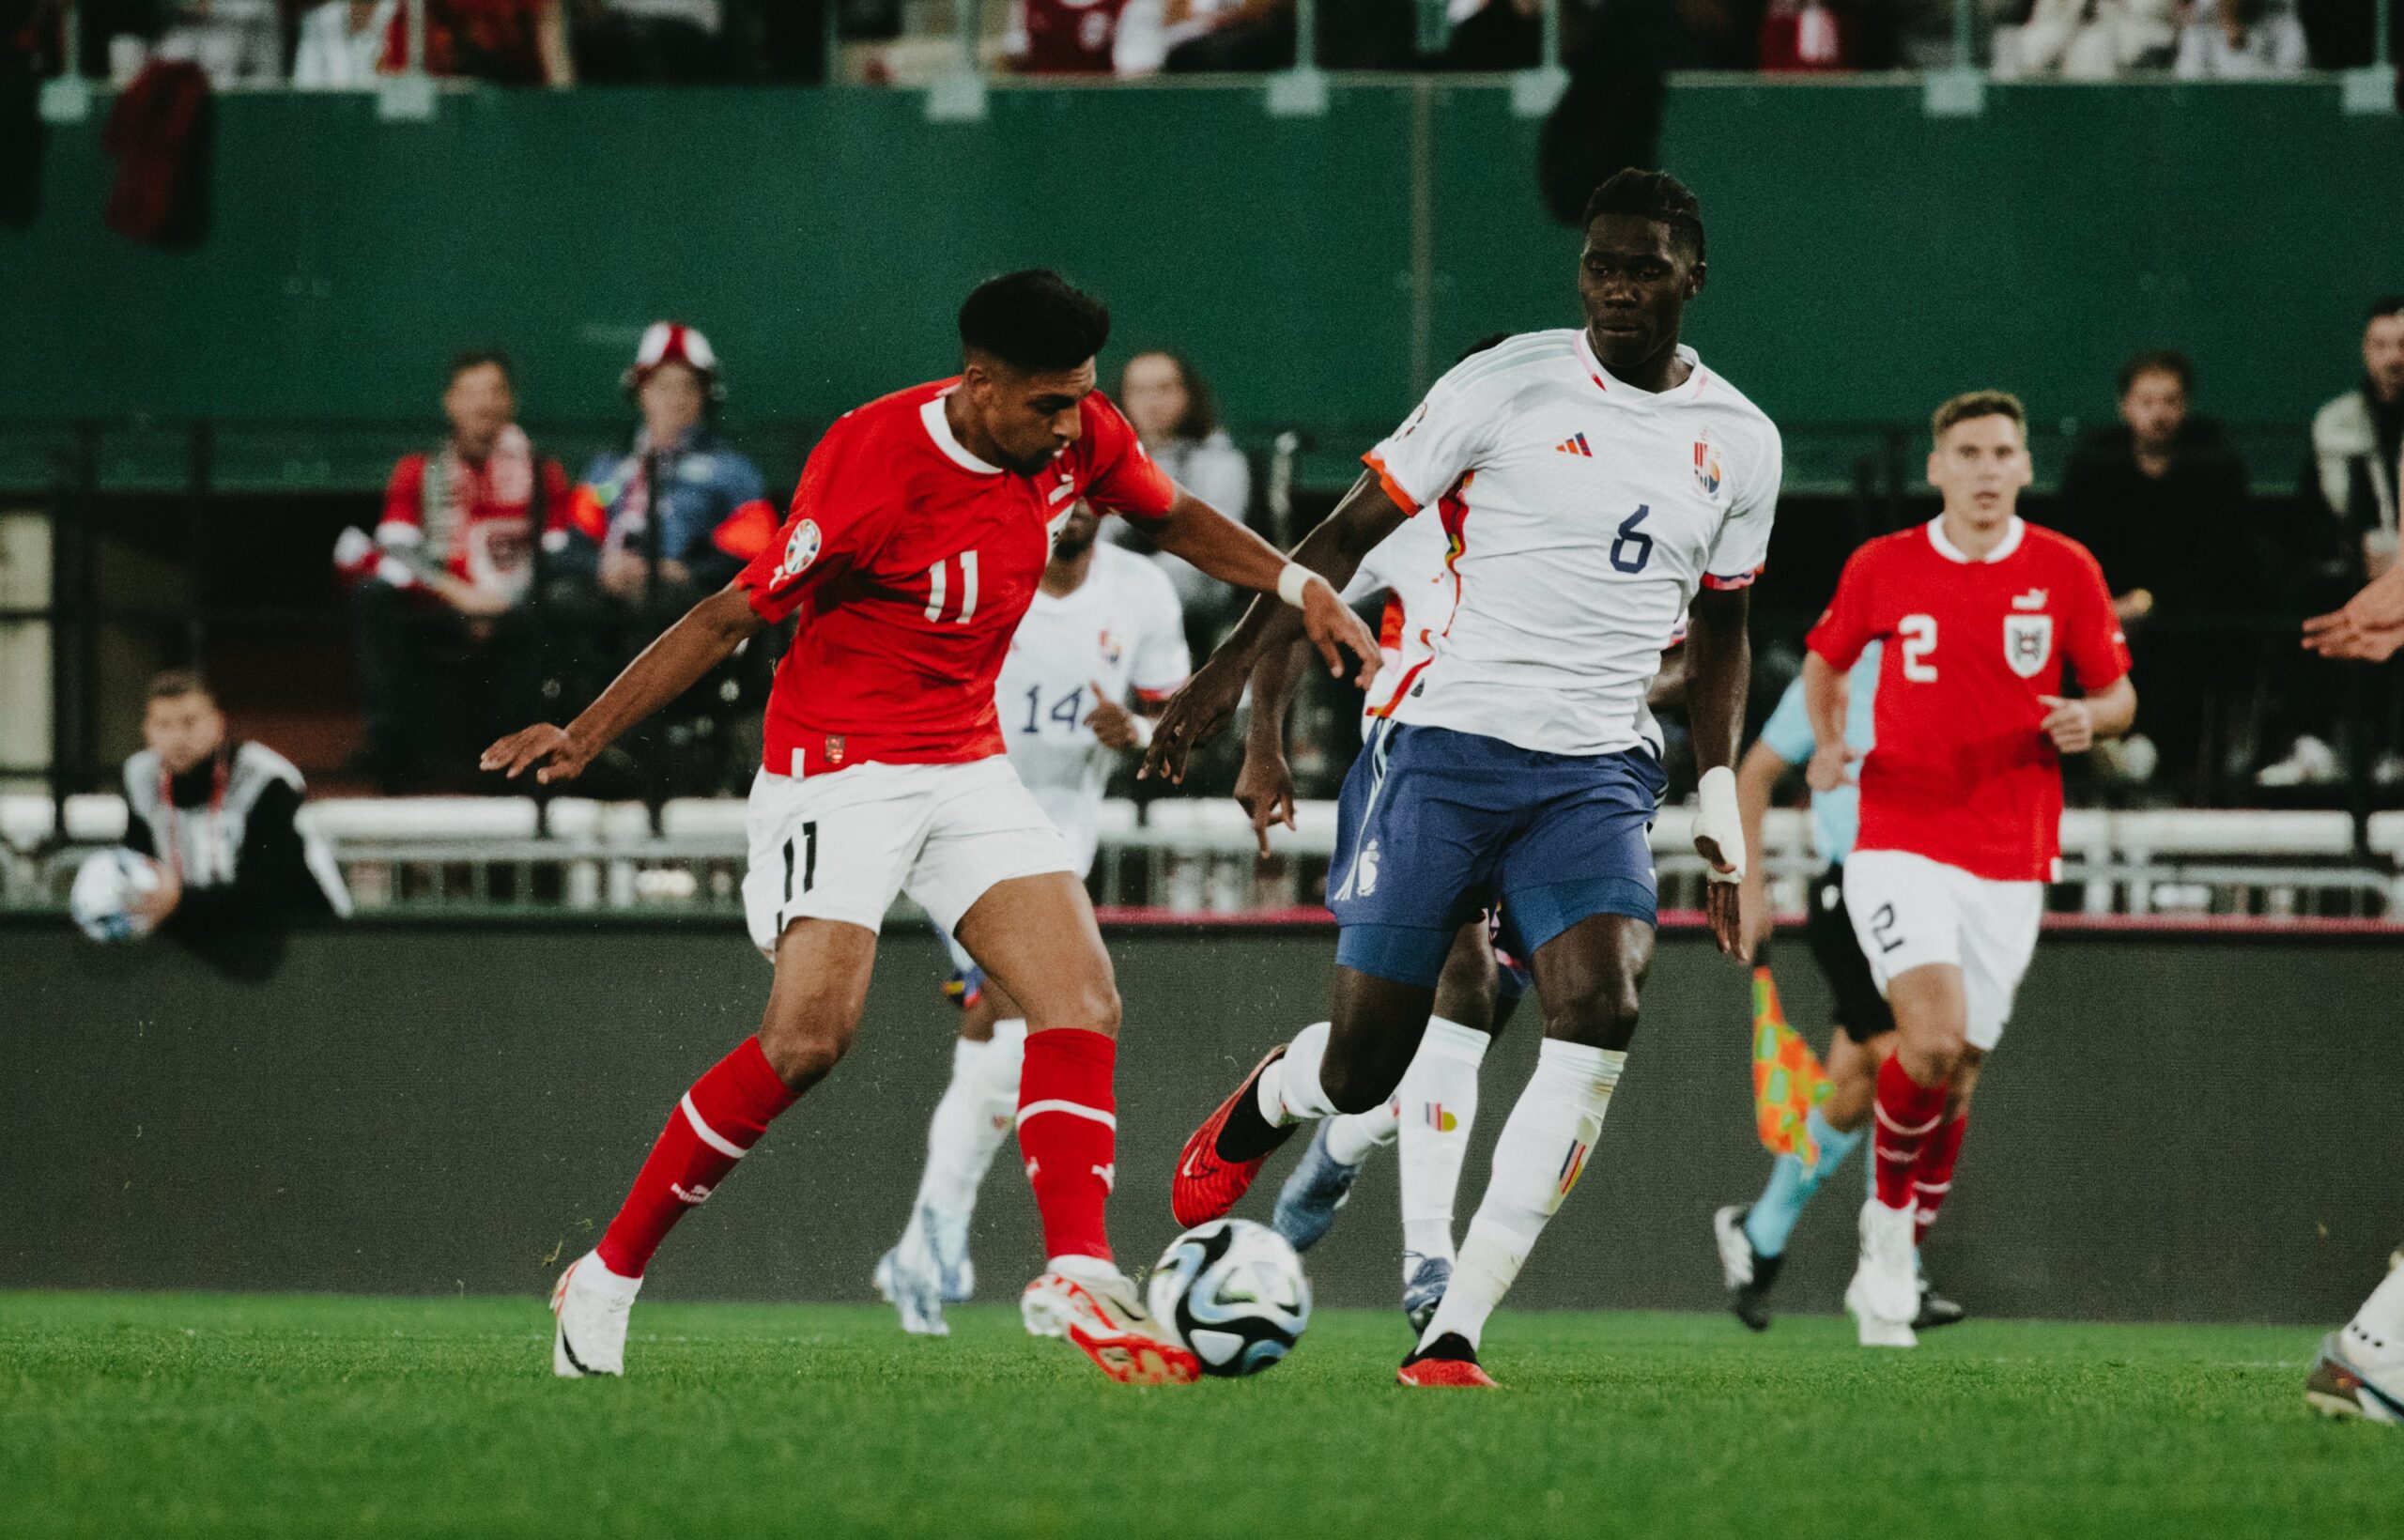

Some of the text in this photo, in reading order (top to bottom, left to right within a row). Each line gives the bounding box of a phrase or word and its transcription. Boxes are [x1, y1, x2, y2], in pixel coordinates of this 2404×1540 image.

[1610, 503, 1653, 574] 6
[924, 550, 978, 624] 11
[1898, 613, 1938, 683] 2
[1022, 684, 1083, 732] 14
[782, 821, 816, 904] 11
[1870, 903, 1903, 953] 2
